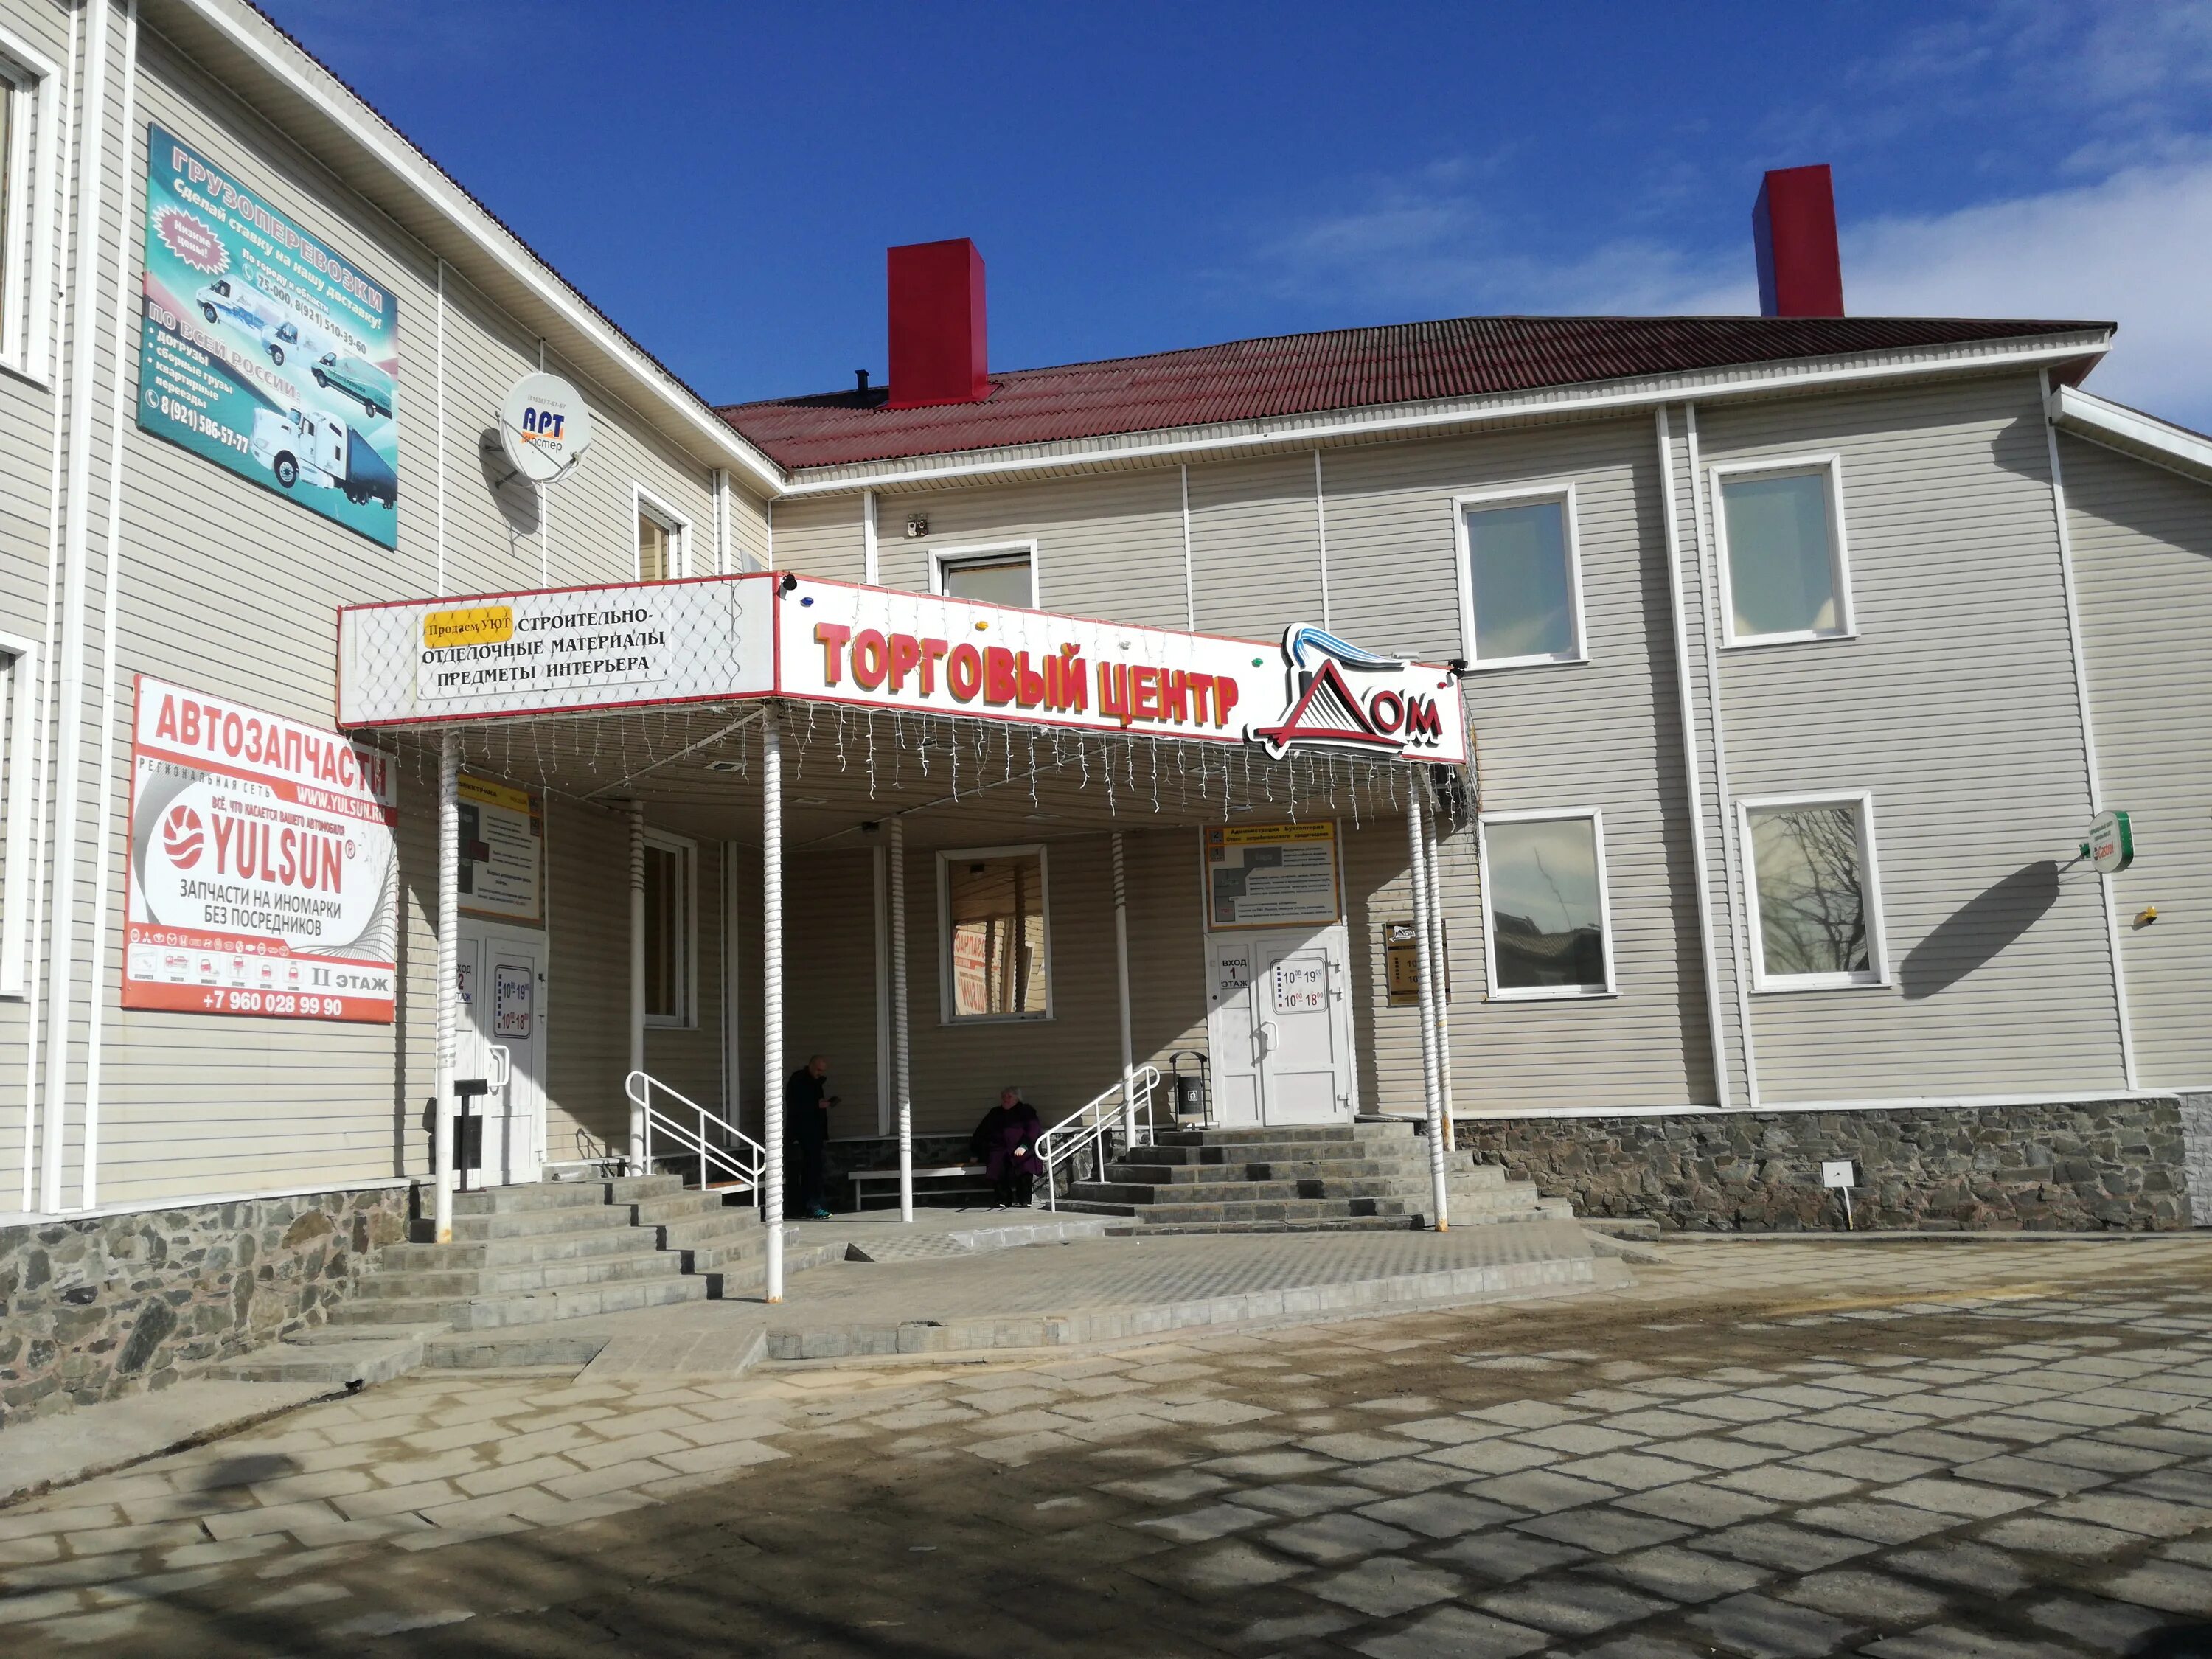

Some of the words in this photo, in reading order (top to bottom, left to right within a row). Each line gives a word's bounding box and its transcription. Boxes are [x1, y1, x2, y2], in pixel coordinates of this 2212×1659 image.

[172, 146, 383, 313] ГРУЗОПЕРЕВОЗКИ
[174, 220, 211, 249] Низкие
[174, 178, 226, 223] Сделай
[229, 217, 274, 260] ставку
[275, 248, 291, 267] на
[293, 262, 324, 291] нашу
[327, 286, 382, 329] доставку!
[177, 235, 208, 258] цены!
[243, 248, 255, 264] По
[257, 259, 287, 286] городу
[289, 282, 296, 291] и
[296, 286, 330, 314] области
[258, 274, 293, 308] 75-000,
[296, 299, 323, 327] 8(921)
[324, 320, 366, 355] 510-39-60
[149, 301, 176, 330] ПО
[180, 319, 227, 361] ВСЕЙ
[157, 330, 209, 366] догрузы
[156, 347, 201, 377] сборные
[204, 372, 233, 394] грузы
[156, 361, 218, 401] квартирные
[156, 376, 206, 408] переезды
[161, 395, 169, 414] 8
[170, 399, 198, 431] (921)
[199, 416, 248, 453] 586-57-77
[523, 407, 565, 437] АРТ
[429, 624, 479, 637] Продаем
[481, 618, 510, 630] УЮТ
[518, 608, 653, 631] СТРОИТЕЛЬНО-
[422, 641, 543, 664] ОТДЕЛОЧНЫЕ
[552, 632, 664, 653] МАТЕРИАЛЫ
[437, 666, 535, 686] ПРЕДМЕТЫ
[547, 656, 650, 677] ИНТЕРЬЕРА
[815, 622, 1087, 711] ТОРГОВЫЙ
[1099, 661, 1239, 727] ЦЕНТР
[156, 693, 386, 797] АВТОЗАПЧАСТИ
[139, 757, 237, 790] РЕГИОНАЛЬНАЯ
[243, 783, 271, 798] СЕТЬ
[229, 800, 243, 814] ЧТО
[279, 810, 305, 827] ВАШЕГО
[296, 785, 385, 822] WWW.YULSUN.RU
[211, 813, 342, 894] YULSUN
[180, 878, 249, 905] ЗАПЧАСТИ
[254, 888, 271, 908] НА
[274, 892, 341, 919] ИНОМАРКИ
[204, 904, 226, 924] БЕЗ
[231, 908, 321, 935] ПОСРЕДНИКОВ
[457, 964, 471, 973] ХОД
[1222, 959, 1247, 967] ВХОД
[1229, 967, 1236, 979] 1
[335, 975, 389, 992] ЭТАЖ
[456, 992, 471, 1001] ТАЖ
[458, 974, 464, 990] 2
[1222, 980, 1248, 988] ЭТАЖ
[203, 990, 224, 1009] +7
[229, 992, 261, 1011] 960
[265, 994, 295, 1013] 028
[299, 996, 319, 1015] 99
[323, 998, 342, 1016] 90
